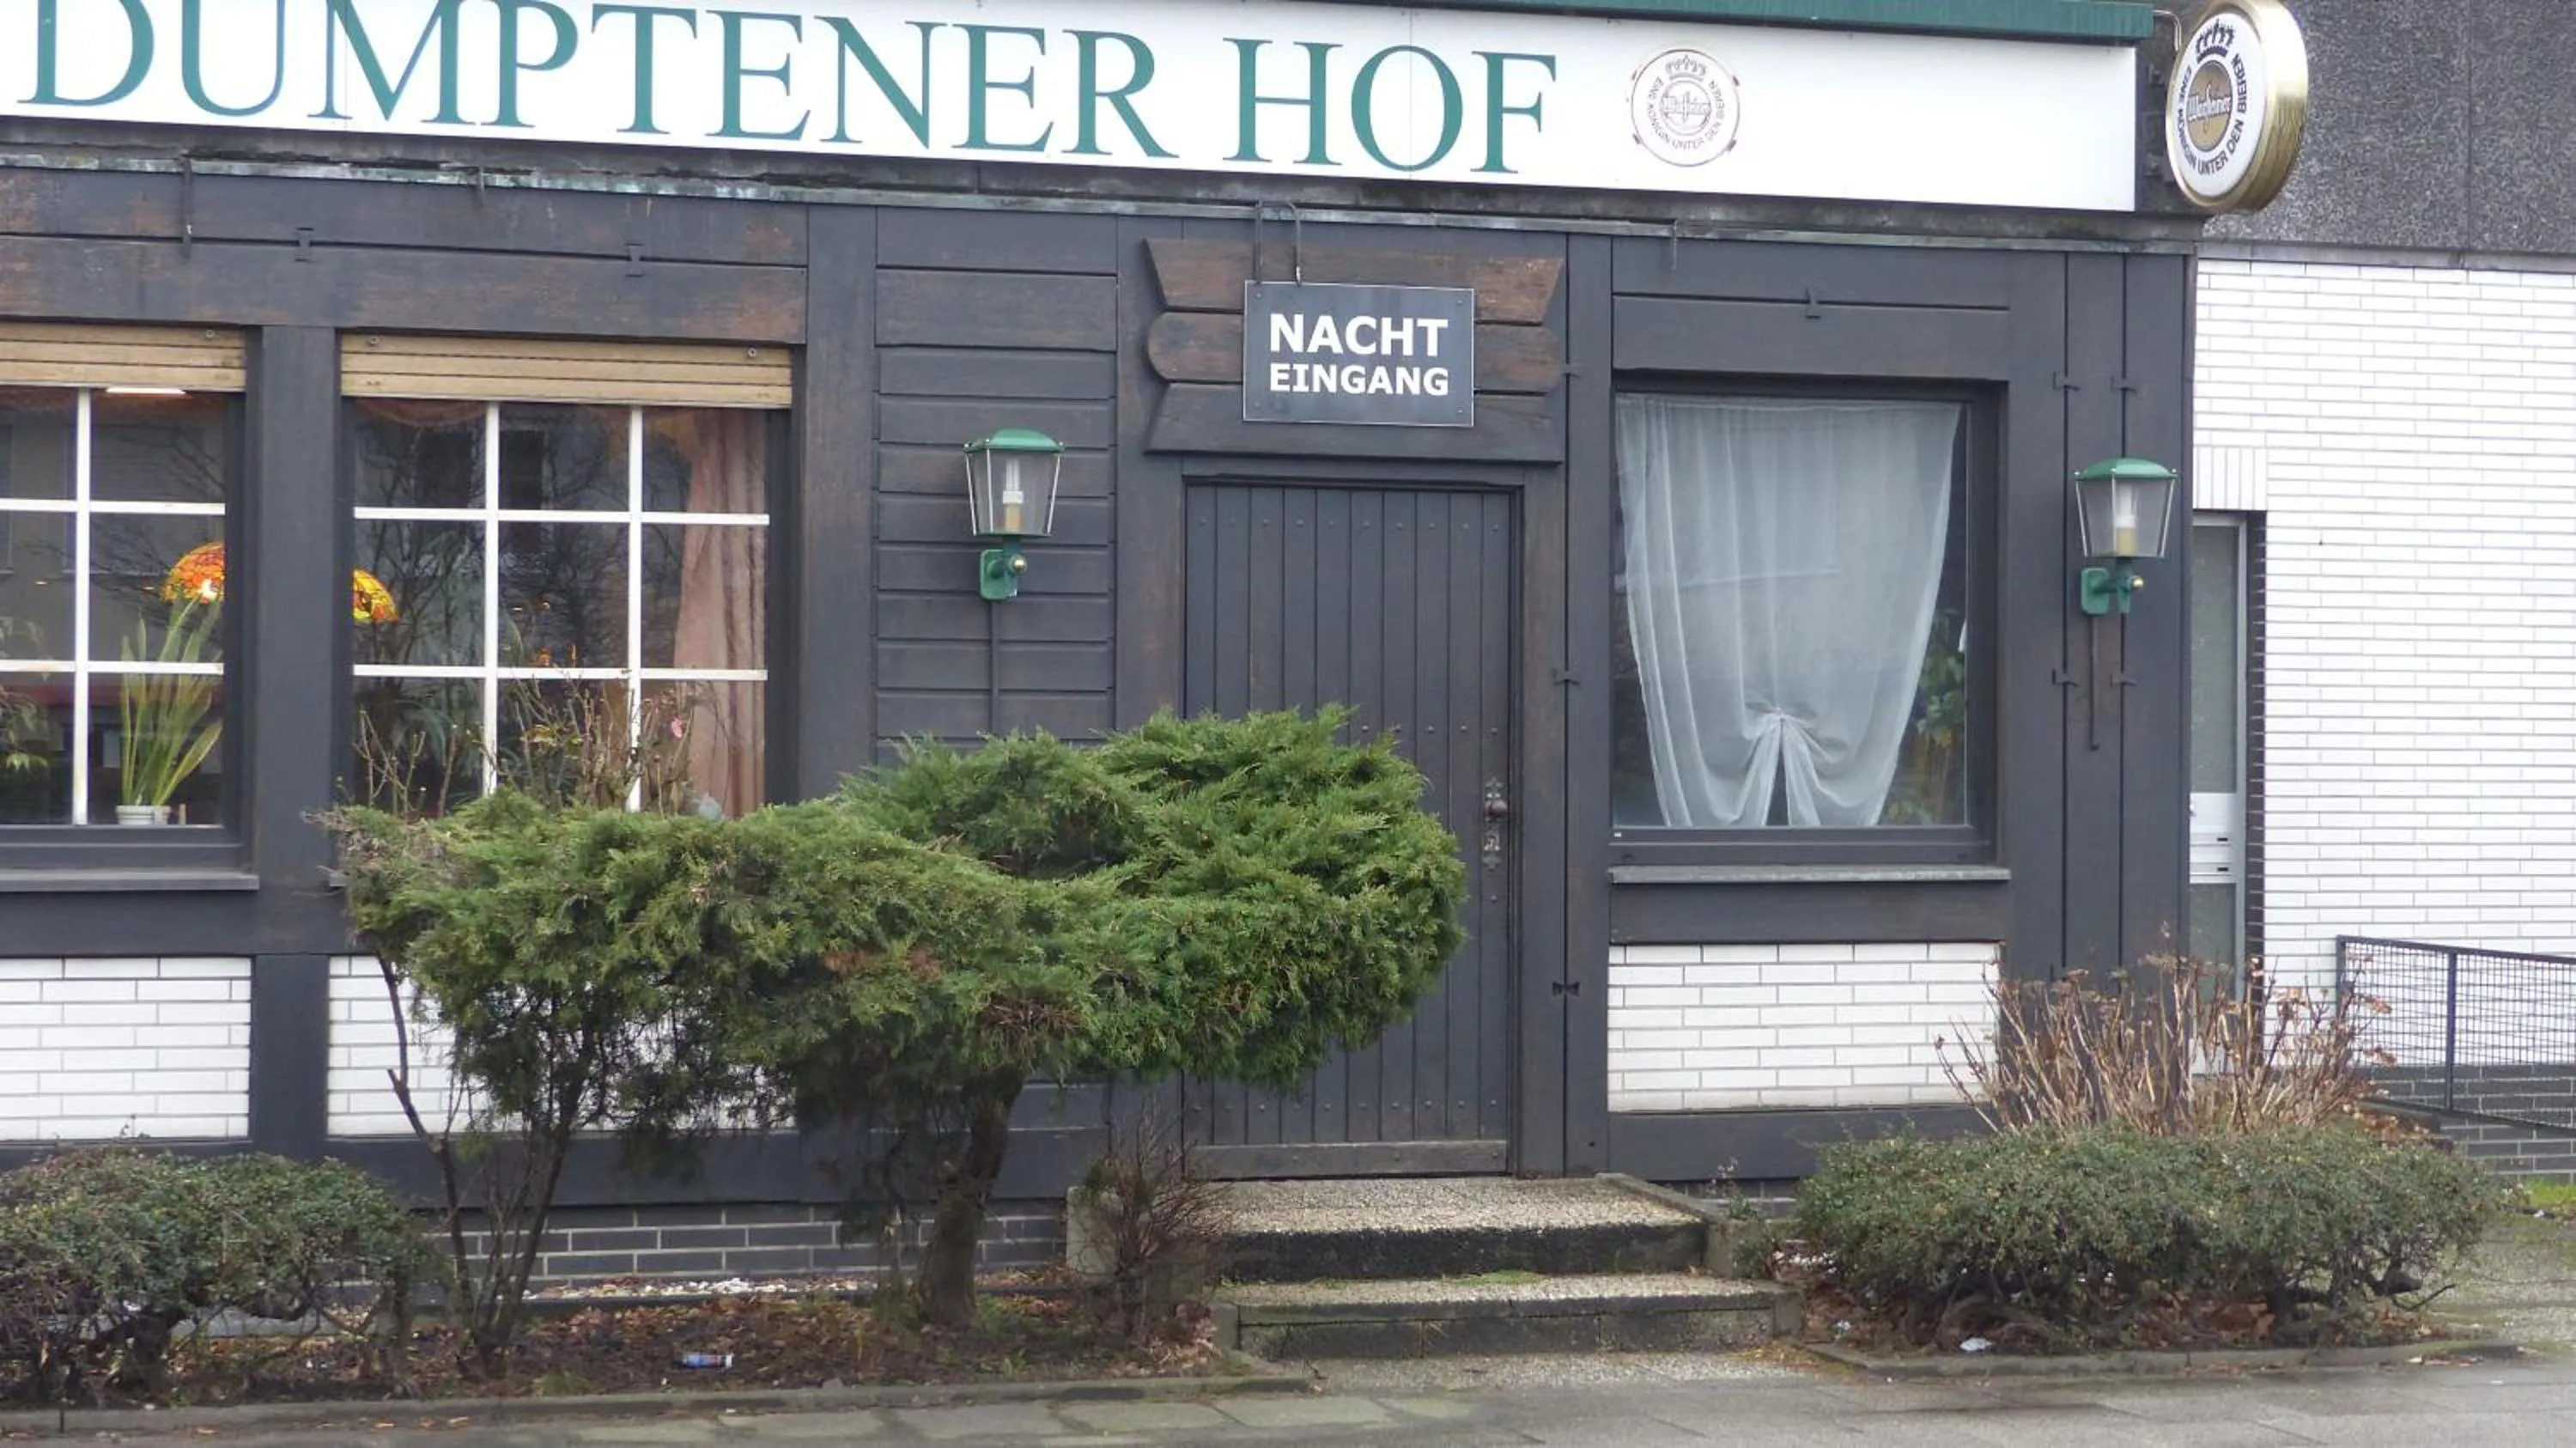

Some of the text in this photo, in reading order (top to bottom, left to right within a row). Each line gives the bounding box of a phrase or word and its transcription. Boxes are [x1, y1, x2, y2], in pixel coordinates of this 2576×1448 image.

[17, 0, 1558, 174] DUMPTENER HOF
[2233, 53, 2247, 113] BIEREN
[2227, 120, 2244, 154] DEN
[2198, 150, 2228, 175] UNTER
[1269, 313, 1449, 357] NACHT
[1269, 362, 1449, 397] EINGANG
